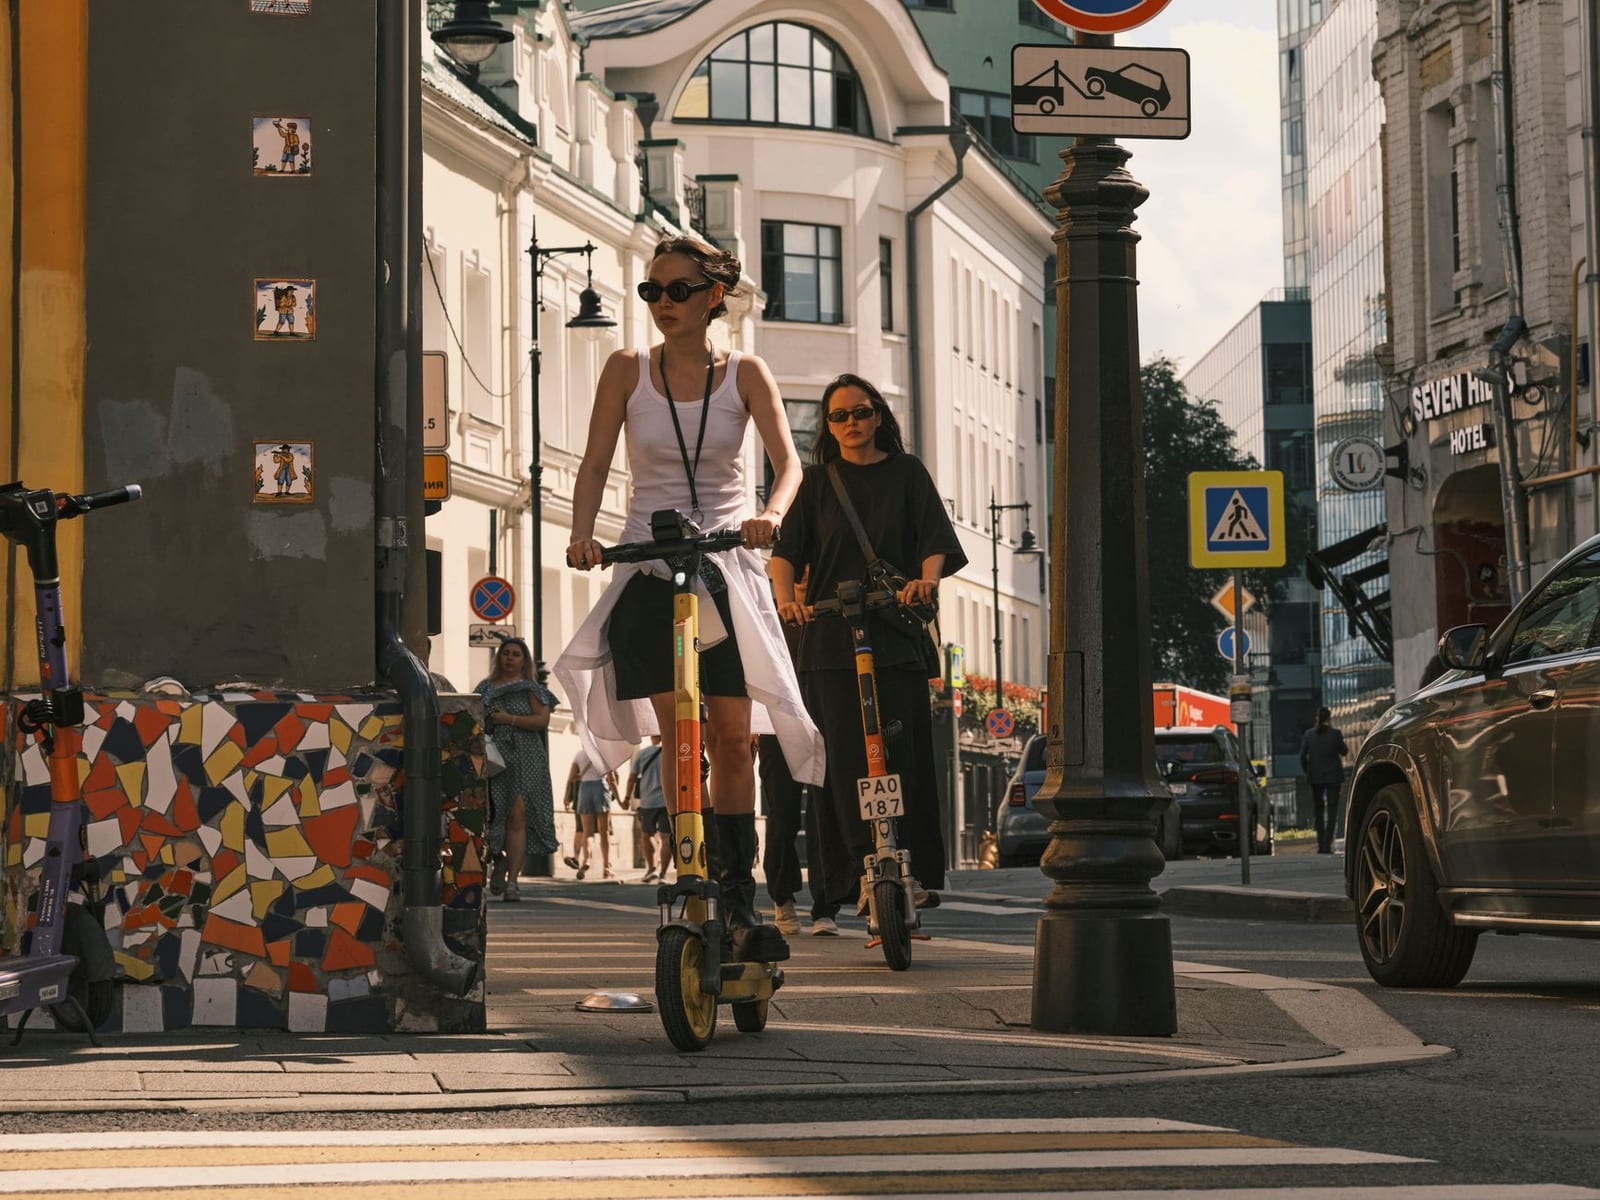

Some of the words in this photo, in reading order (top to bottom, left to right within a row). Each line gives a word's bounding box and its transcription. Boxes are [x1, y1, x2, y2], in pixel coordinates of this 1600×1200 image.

[1412, 374, 1462, 422] SEVEN
[1450, 424, 1487, 455] HOTEL
[864, 799, 900, 817] 187
